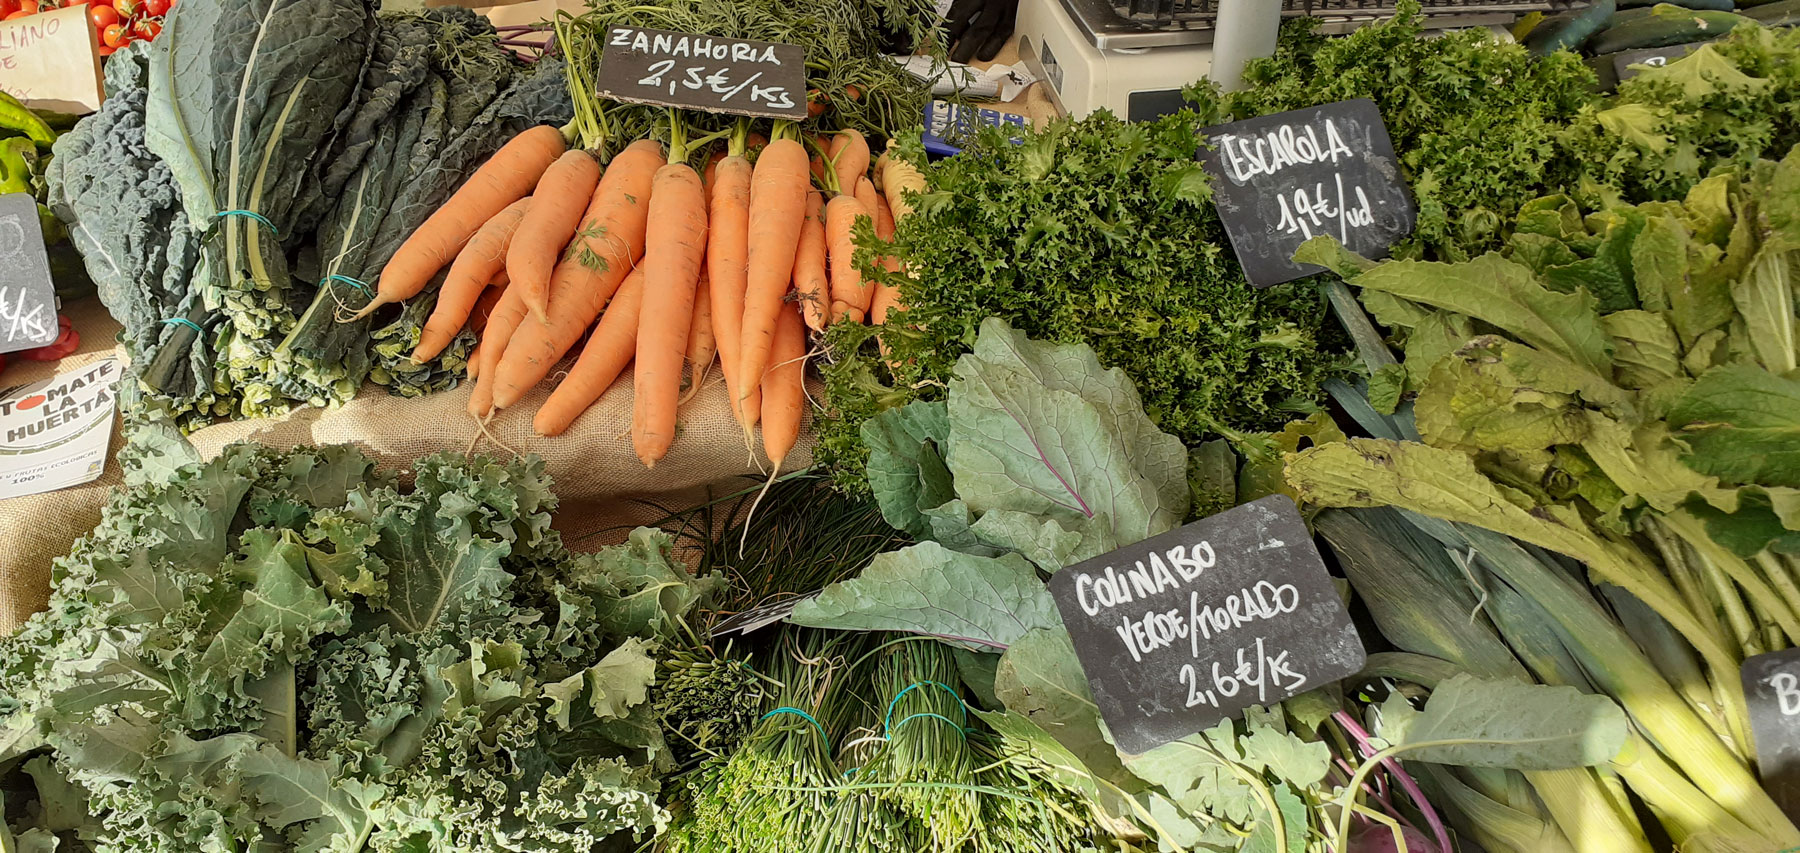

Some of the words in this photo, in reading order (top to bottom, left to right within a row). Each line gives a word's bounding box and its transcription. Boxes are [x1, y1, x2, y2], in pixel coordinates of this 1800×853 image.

[609, 28, 781, 65] ZANAHORIA
[1221, 118, 1354, 182] ESCAROLA
[1276, 172, 1376, 246] 1,9€/ud
[43, 396, 77, 417] LA
[11, 473, 45, 485] 100%
[1075, 540, 1217, 617] COLINABO
